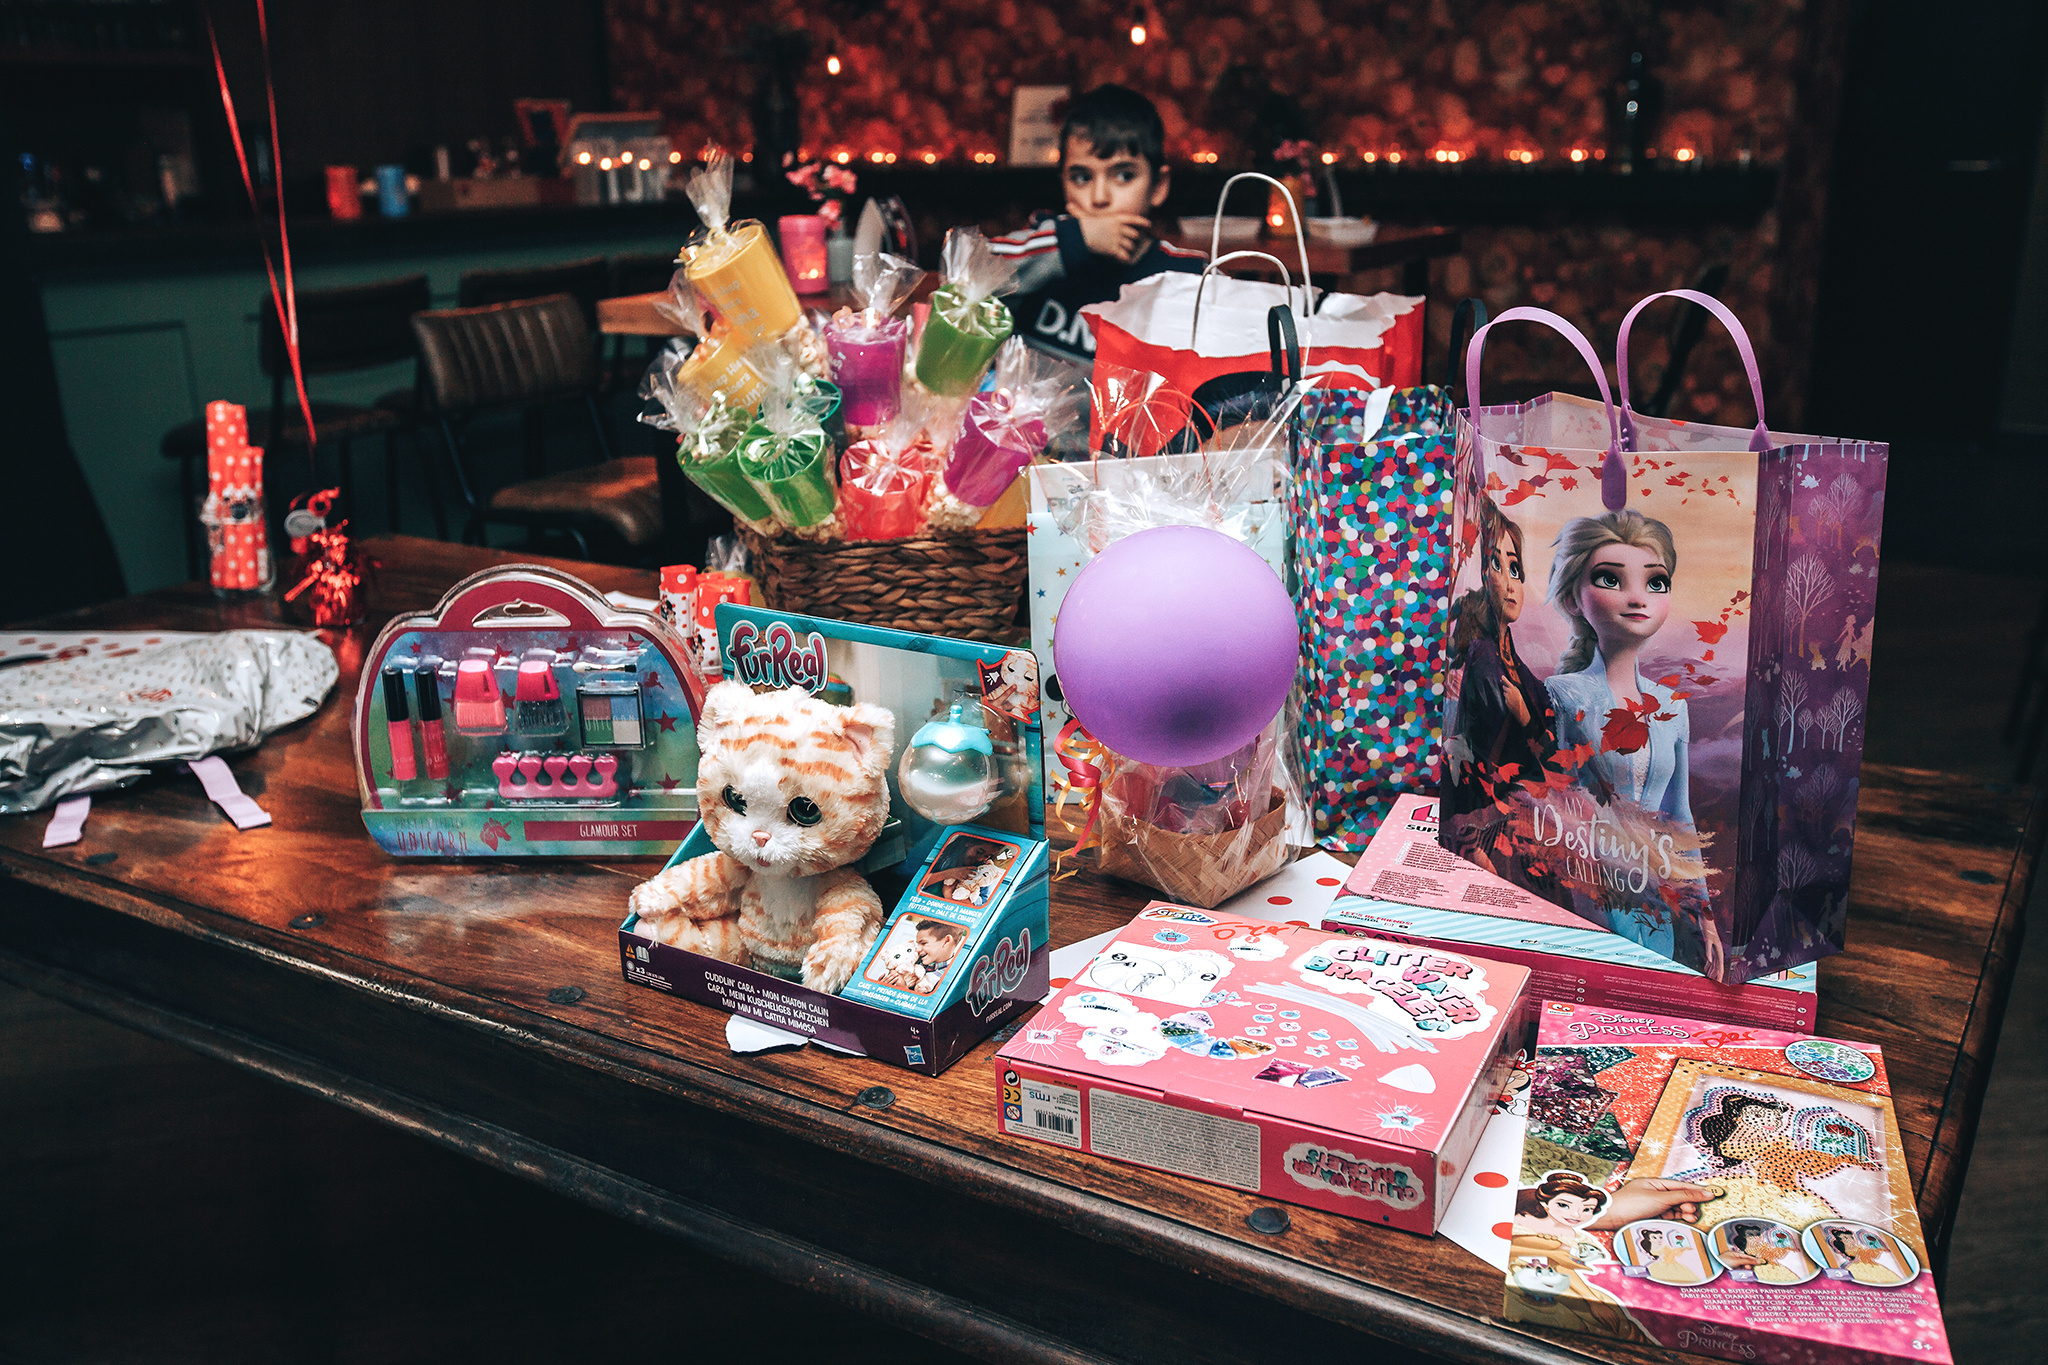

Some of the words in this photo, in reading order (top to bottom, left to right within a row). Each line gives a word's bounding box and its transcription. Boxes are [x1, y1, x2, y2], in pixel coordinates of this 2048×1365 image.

[1564, 797, 1585, 818] MY
[396, 831, 468, 852] UNICORN
[580, 824, 619, 838] GLAMOUR
[620, 824, 637, 837] SET
[1534, 804, 1673, 894] Destiny's
[1567, 855, 1625, 893] CALLING
[705, 971, 735, 987] CUDDLIN'
[738, 981, 755, 994] CARA
[762, 989, 779, 1001] MON
[729, 989, 746, 1002] MEIN
[1304, 956, 1451, 1032] BRACELETS
[1329, 946, 1473, 979] GLITTER
[1402, 966, 1481, 1024] WATER
[722, 997, 735, 1009] MIU
[738, 1002, 751, 1014] MIU
[753, 1006, 763, 1017] MI
[788, 1017, 817, 1034] MIMOSA
[1029, 1091, 1051, 1102] rms
[1292, 1158, 1347, 1188] WATER
[1306, 1149, 1409, 1188] BRACELETS
[1348, 1175, 1419, 1202] GLITTER
[1911, 1339, 1934, 1351] 3+
